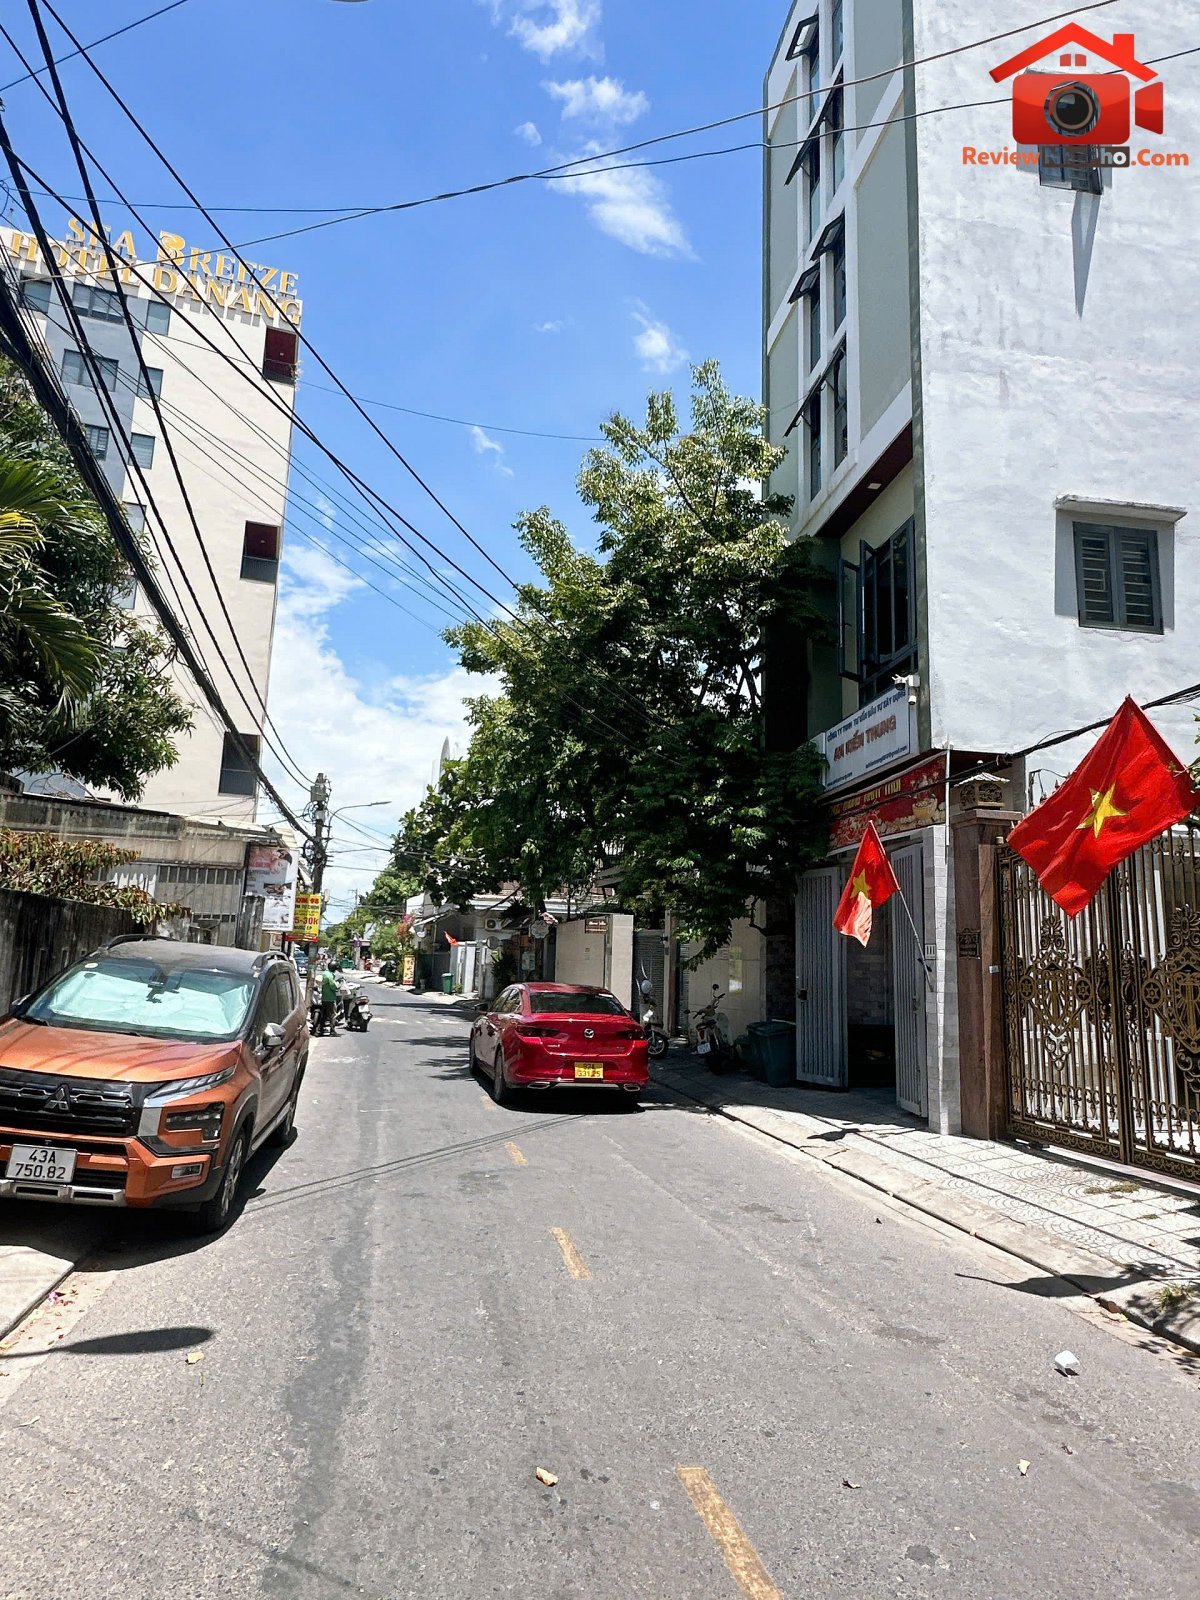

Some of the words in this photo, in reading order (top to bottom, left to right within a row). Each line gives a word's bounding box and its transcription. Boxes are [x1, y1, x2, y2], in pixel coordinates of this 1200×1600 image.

[10, 233, 141, 287] HOTEL
[153, 266, 302, 325] DANANG
[157, 230, 299, 296] BREEZE
[15, 1163, 66, 1180] 750.82
[29, 1149, 56, 1164] 43A
